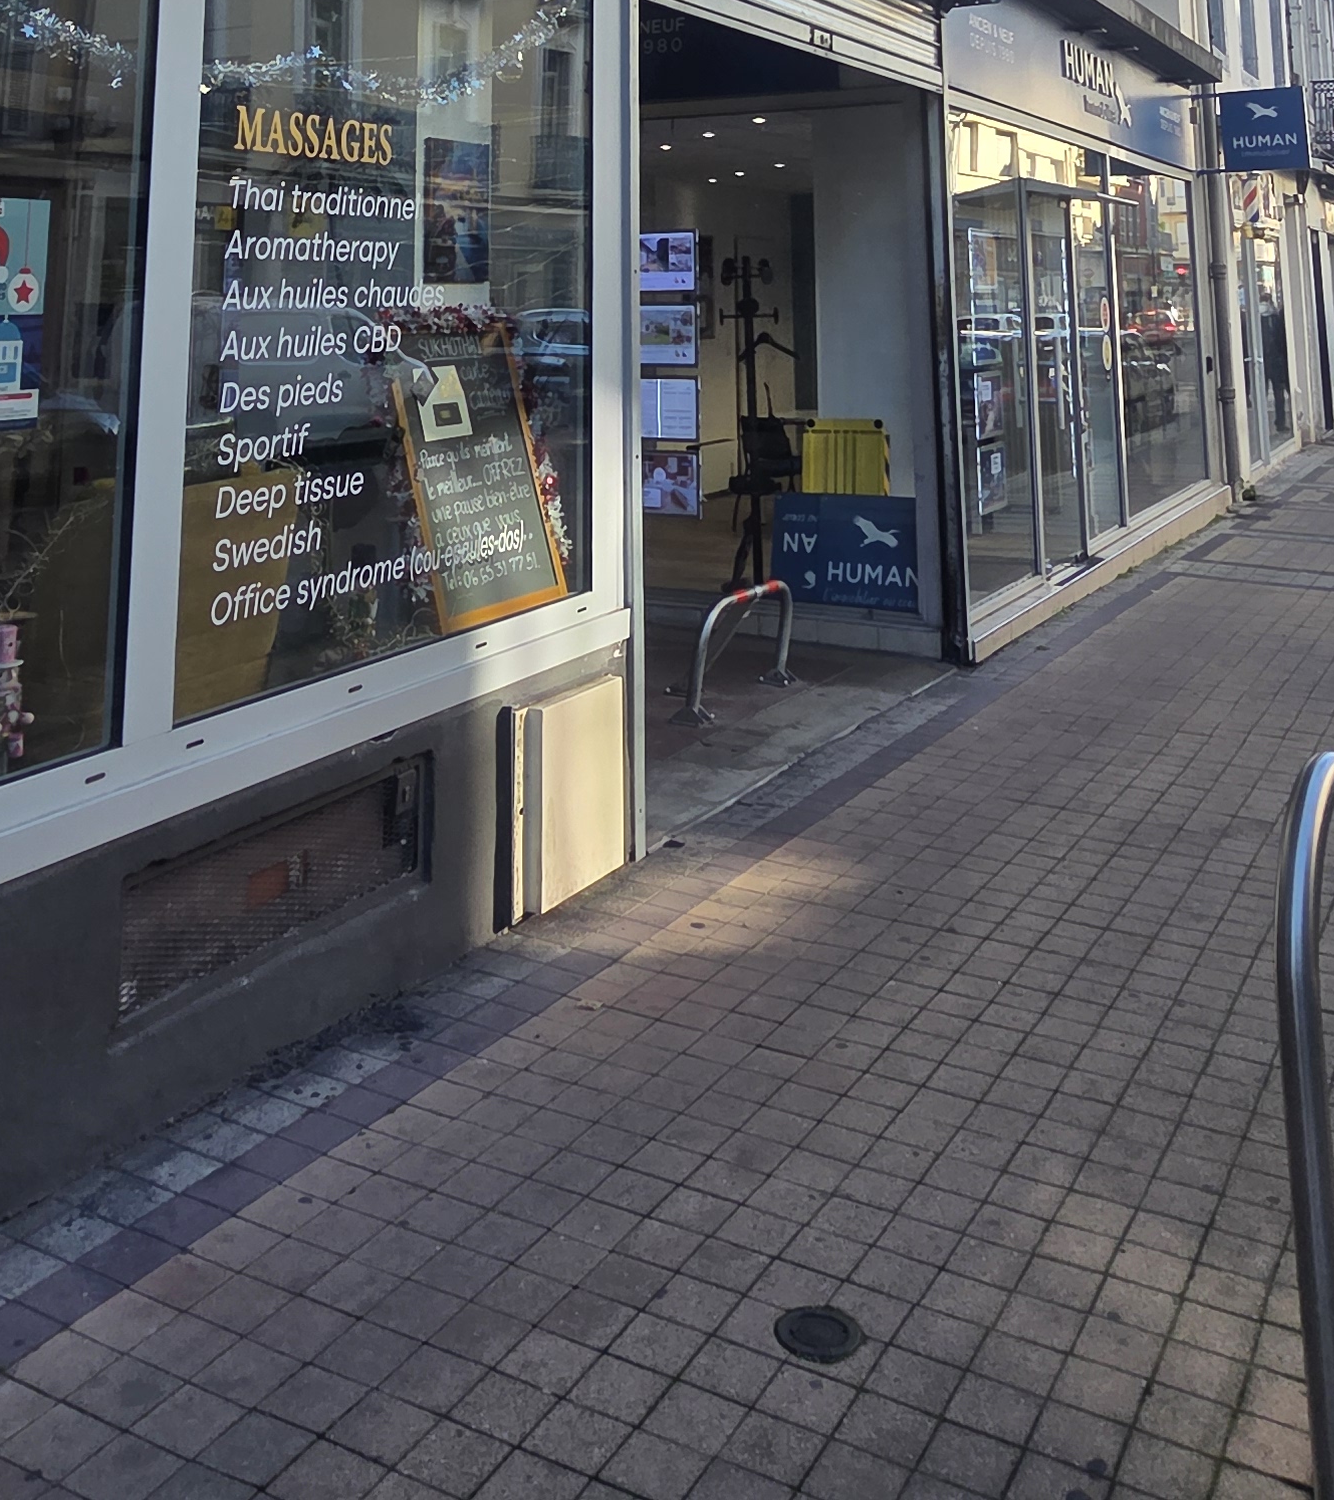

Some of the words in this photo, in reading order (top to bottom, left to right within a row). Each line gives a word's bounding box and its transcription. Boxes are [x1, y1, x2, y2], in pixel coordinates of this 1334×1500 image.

[640, 17, 685, 35] NEUF
[643, 37, 683, 55] 980
[1061, 39, 1114, 98] HUMAN
[233, 105, 394, 166] MASSAGES
[1232, 132, 1298, 149] HUMAN
[229, 178, 286, 212] Thai
[291, 184, 422, 222] traditionnel
[224, 230, 400, 270] Aromatherapy
[222, 279, 272, 310] Aux
[278, 277, 349, 309] huiles
[353, 279, 446, 308] chaudes
[220, 331, 270, 363] Aux
[276, 327, 348, 358] huiles
[352, 325, 402, 353] CBD
[218, 382, 271, 414] Des
[276, 373, 344, 417] pieds
[216, 422, 310, 473] Sportif
[483, 457, 526, 486] OFFREZ
[215, 483, 287, 523] Deep
[293, 470, 365, 507] tissue
[454, 494, 485, 524] pause
[212, 520, 322, 573] Swedish
[462, 571, 479, 588] 06
[480, 566, 495, 586] 65
[495, 560, 508, 577] 31
[508, 554, 524, 572] 77
[827, 561, 919, 587] HUMAN
[210, 583, 292, 626] Office
[296, 559, 405, 611] syndrome
